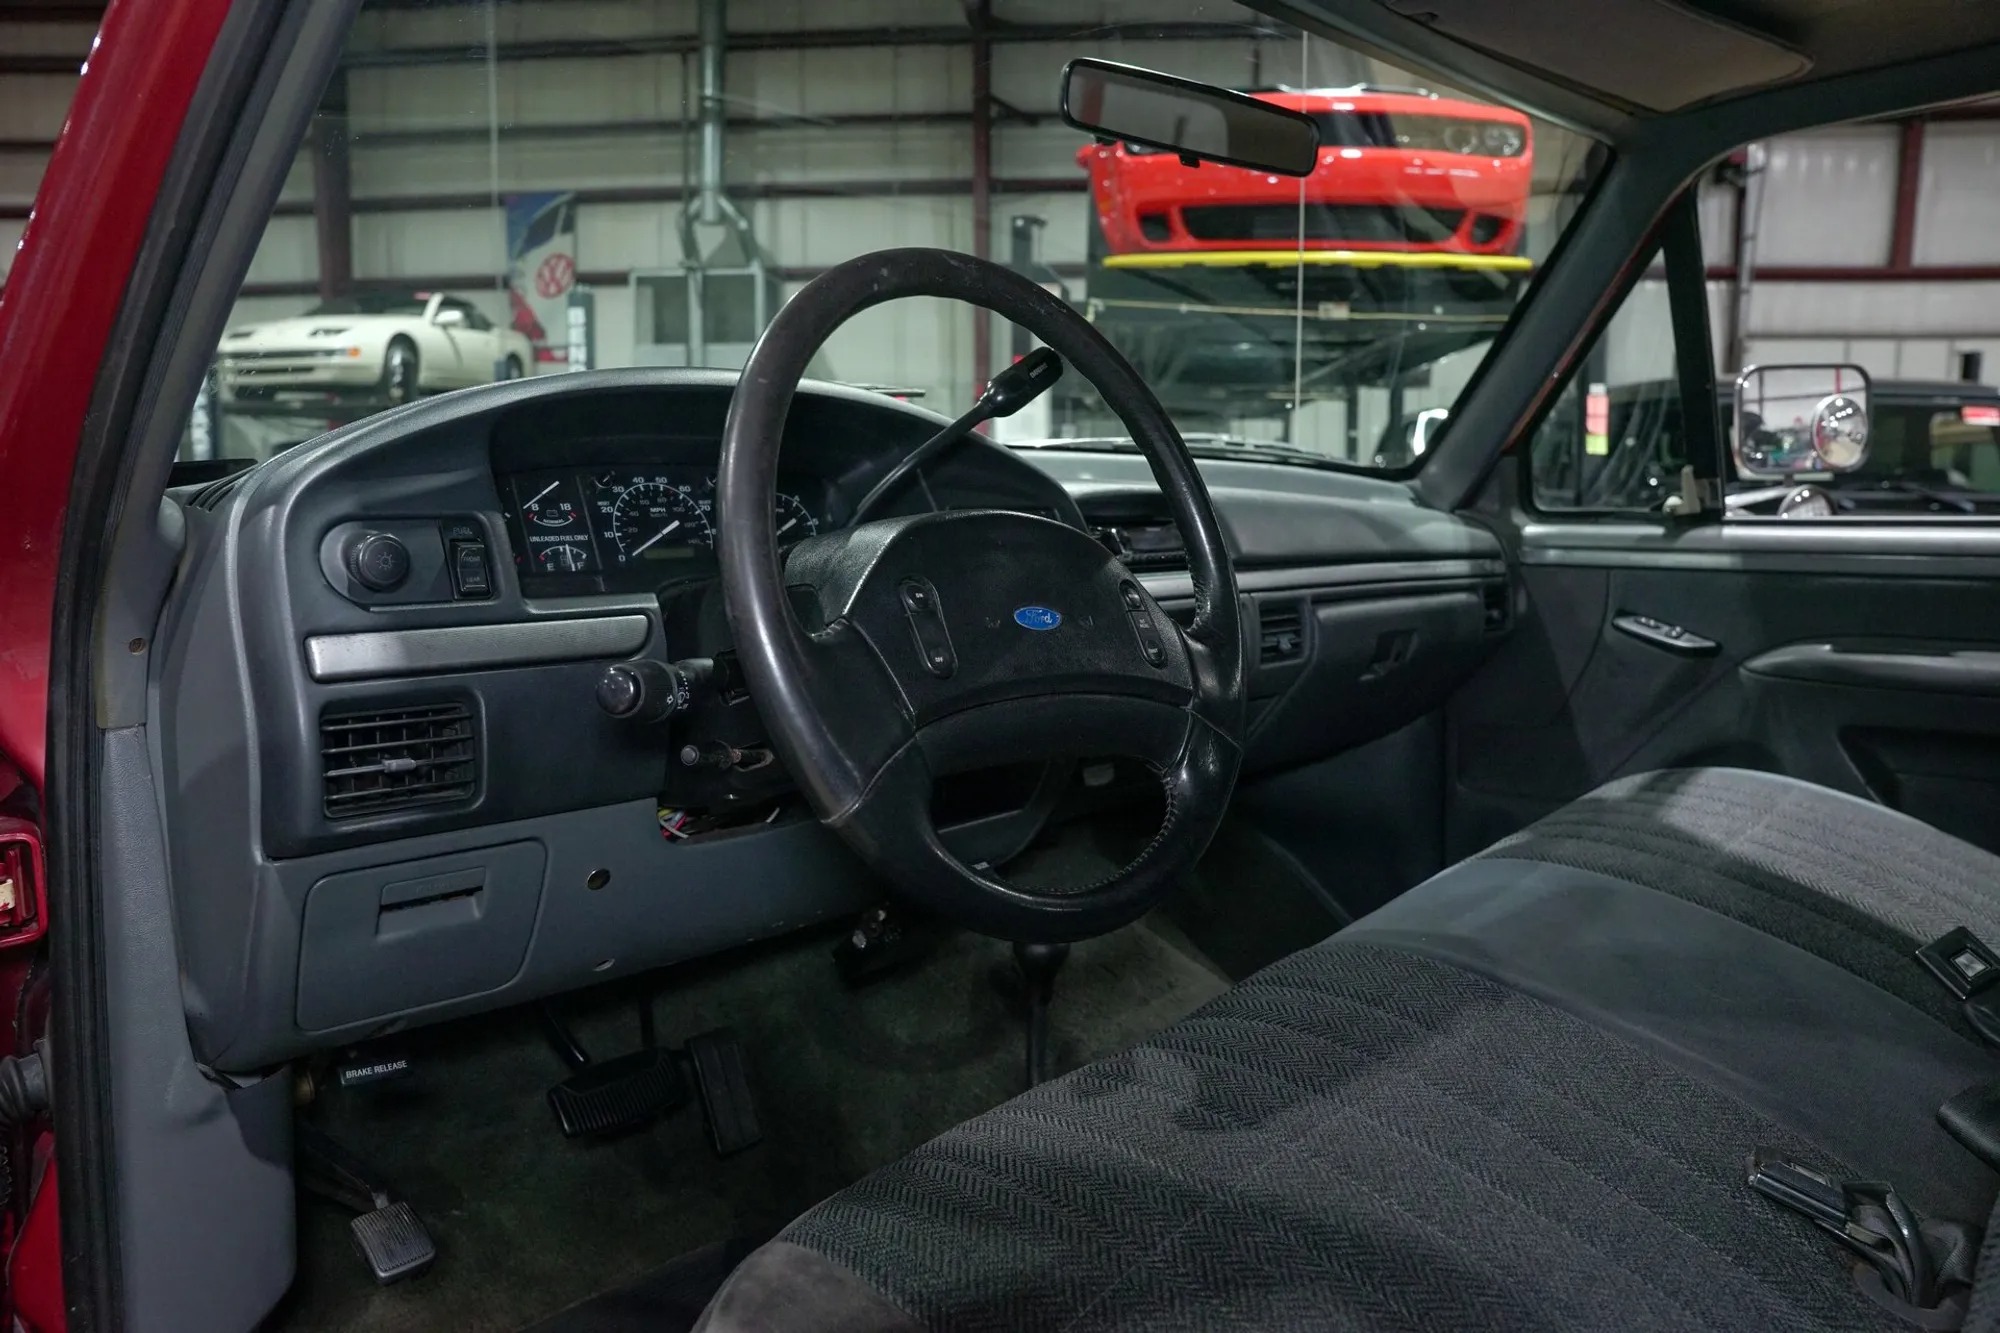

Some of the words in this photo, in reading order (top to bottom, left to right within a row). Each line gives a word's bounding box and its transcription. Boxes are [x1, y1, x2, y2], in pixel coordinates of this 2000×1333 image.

[611, 485, 625, 493] 30
[678, 485, 692, 493] 60
[531, 503, 540, 511] 8
[559, 503, 573, 511] 18
[546, 562, 555, 571] E
[576, 561, 584, 570] F
[346, 1066, 373, 1079] BRAKE
[373, 1060, 408, 1074] RELEASE
